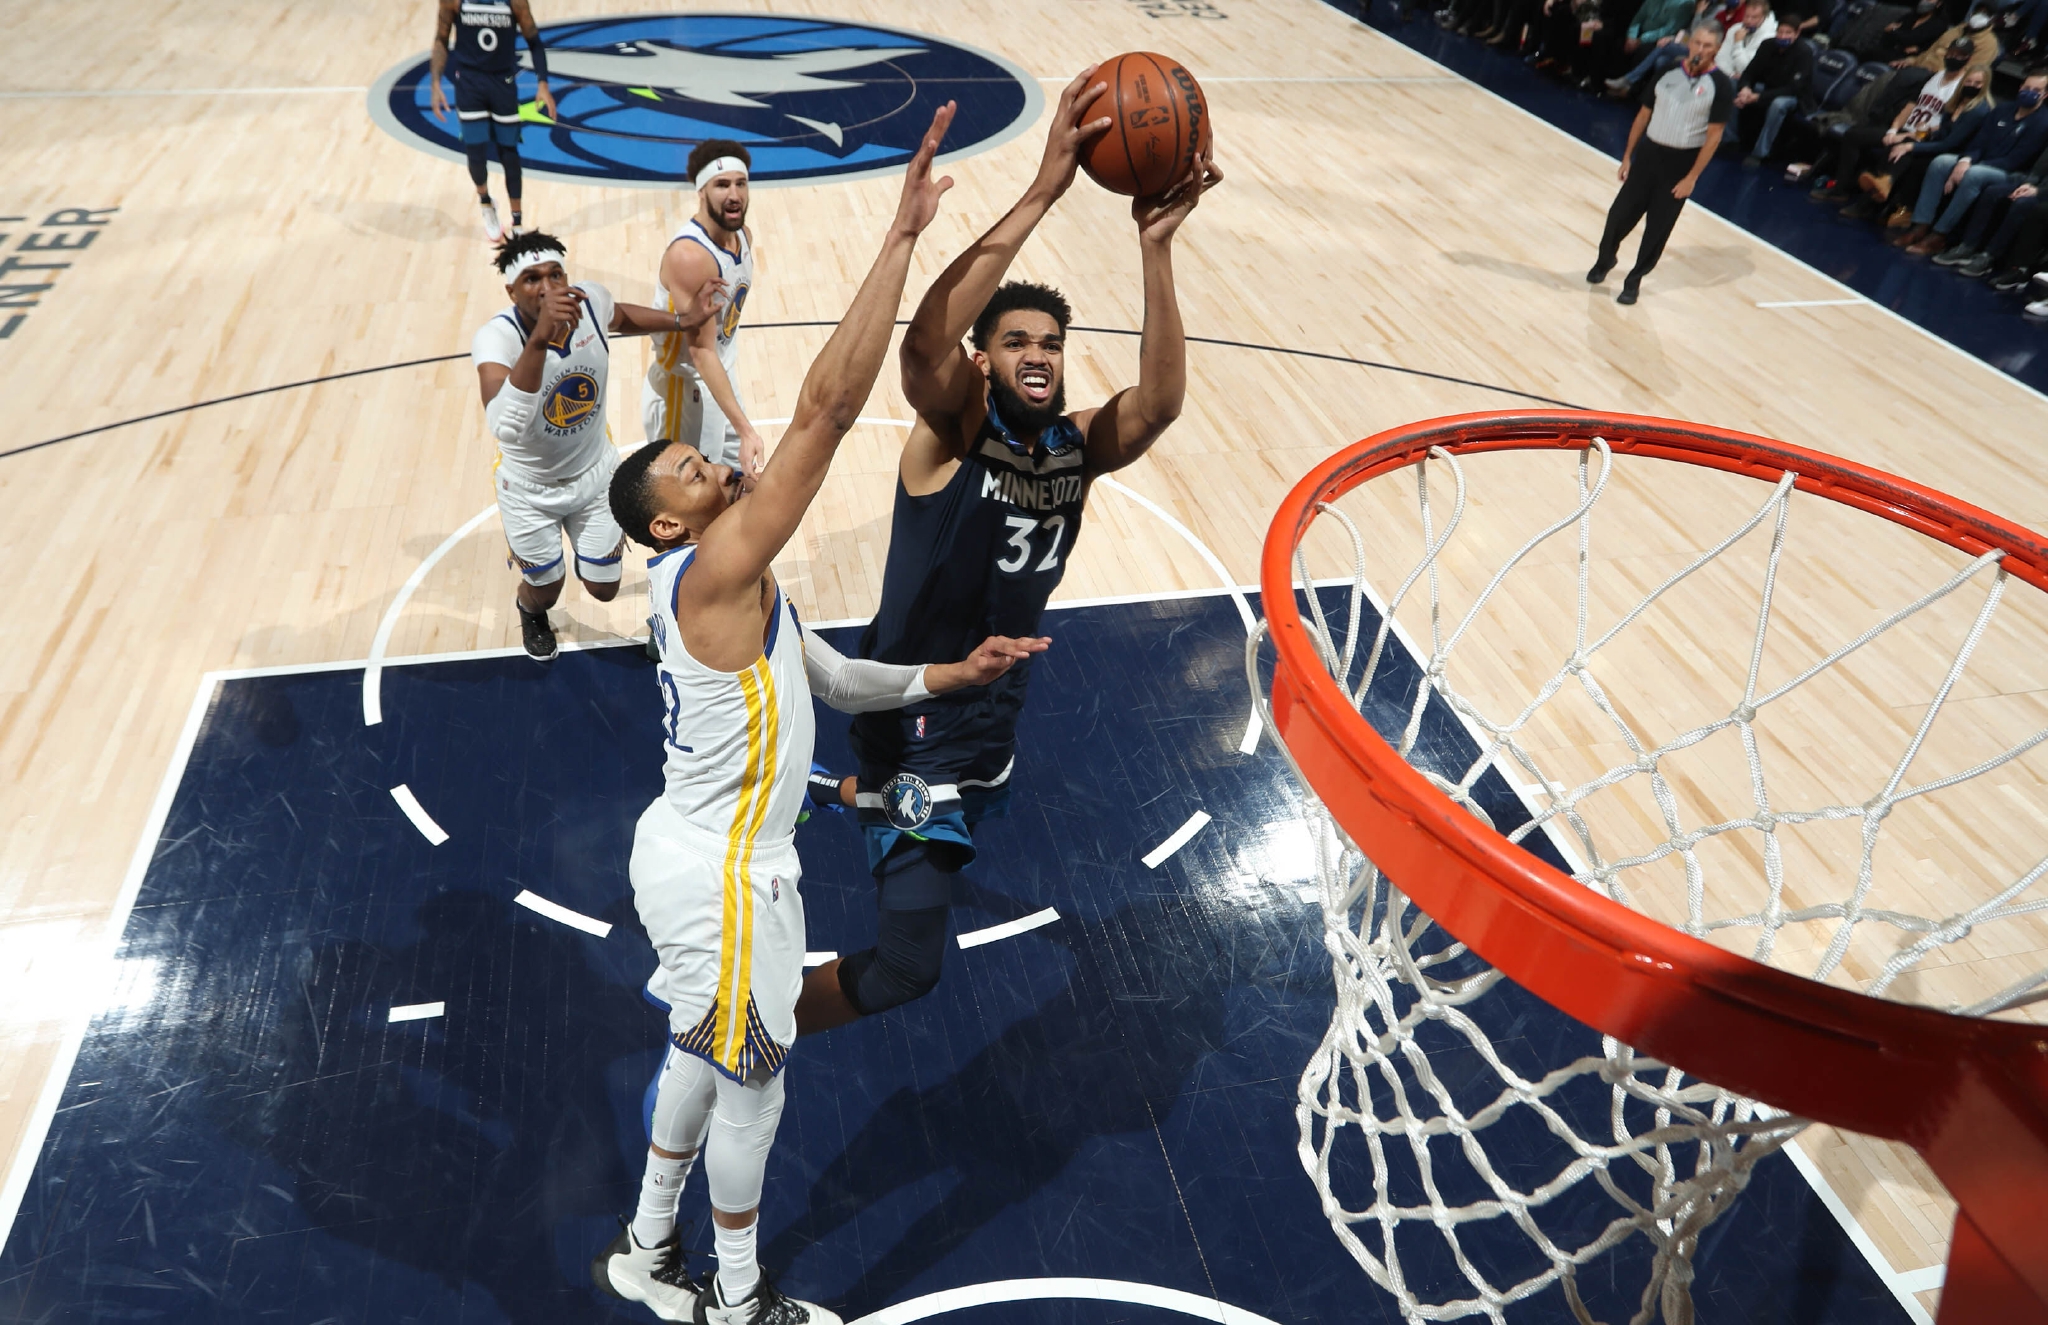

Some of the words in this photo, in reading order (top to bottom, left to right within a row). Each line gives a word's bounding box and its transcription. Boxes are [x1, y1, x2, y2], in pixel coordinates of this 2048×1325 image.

[477, 28, 498, 52] 0
[542, 367, 571, 397] GOLDEN
[574, 365, 597, 377] STATE
[578, 383, 589, 398] 5
[997, 514, 1066, 573] 32
